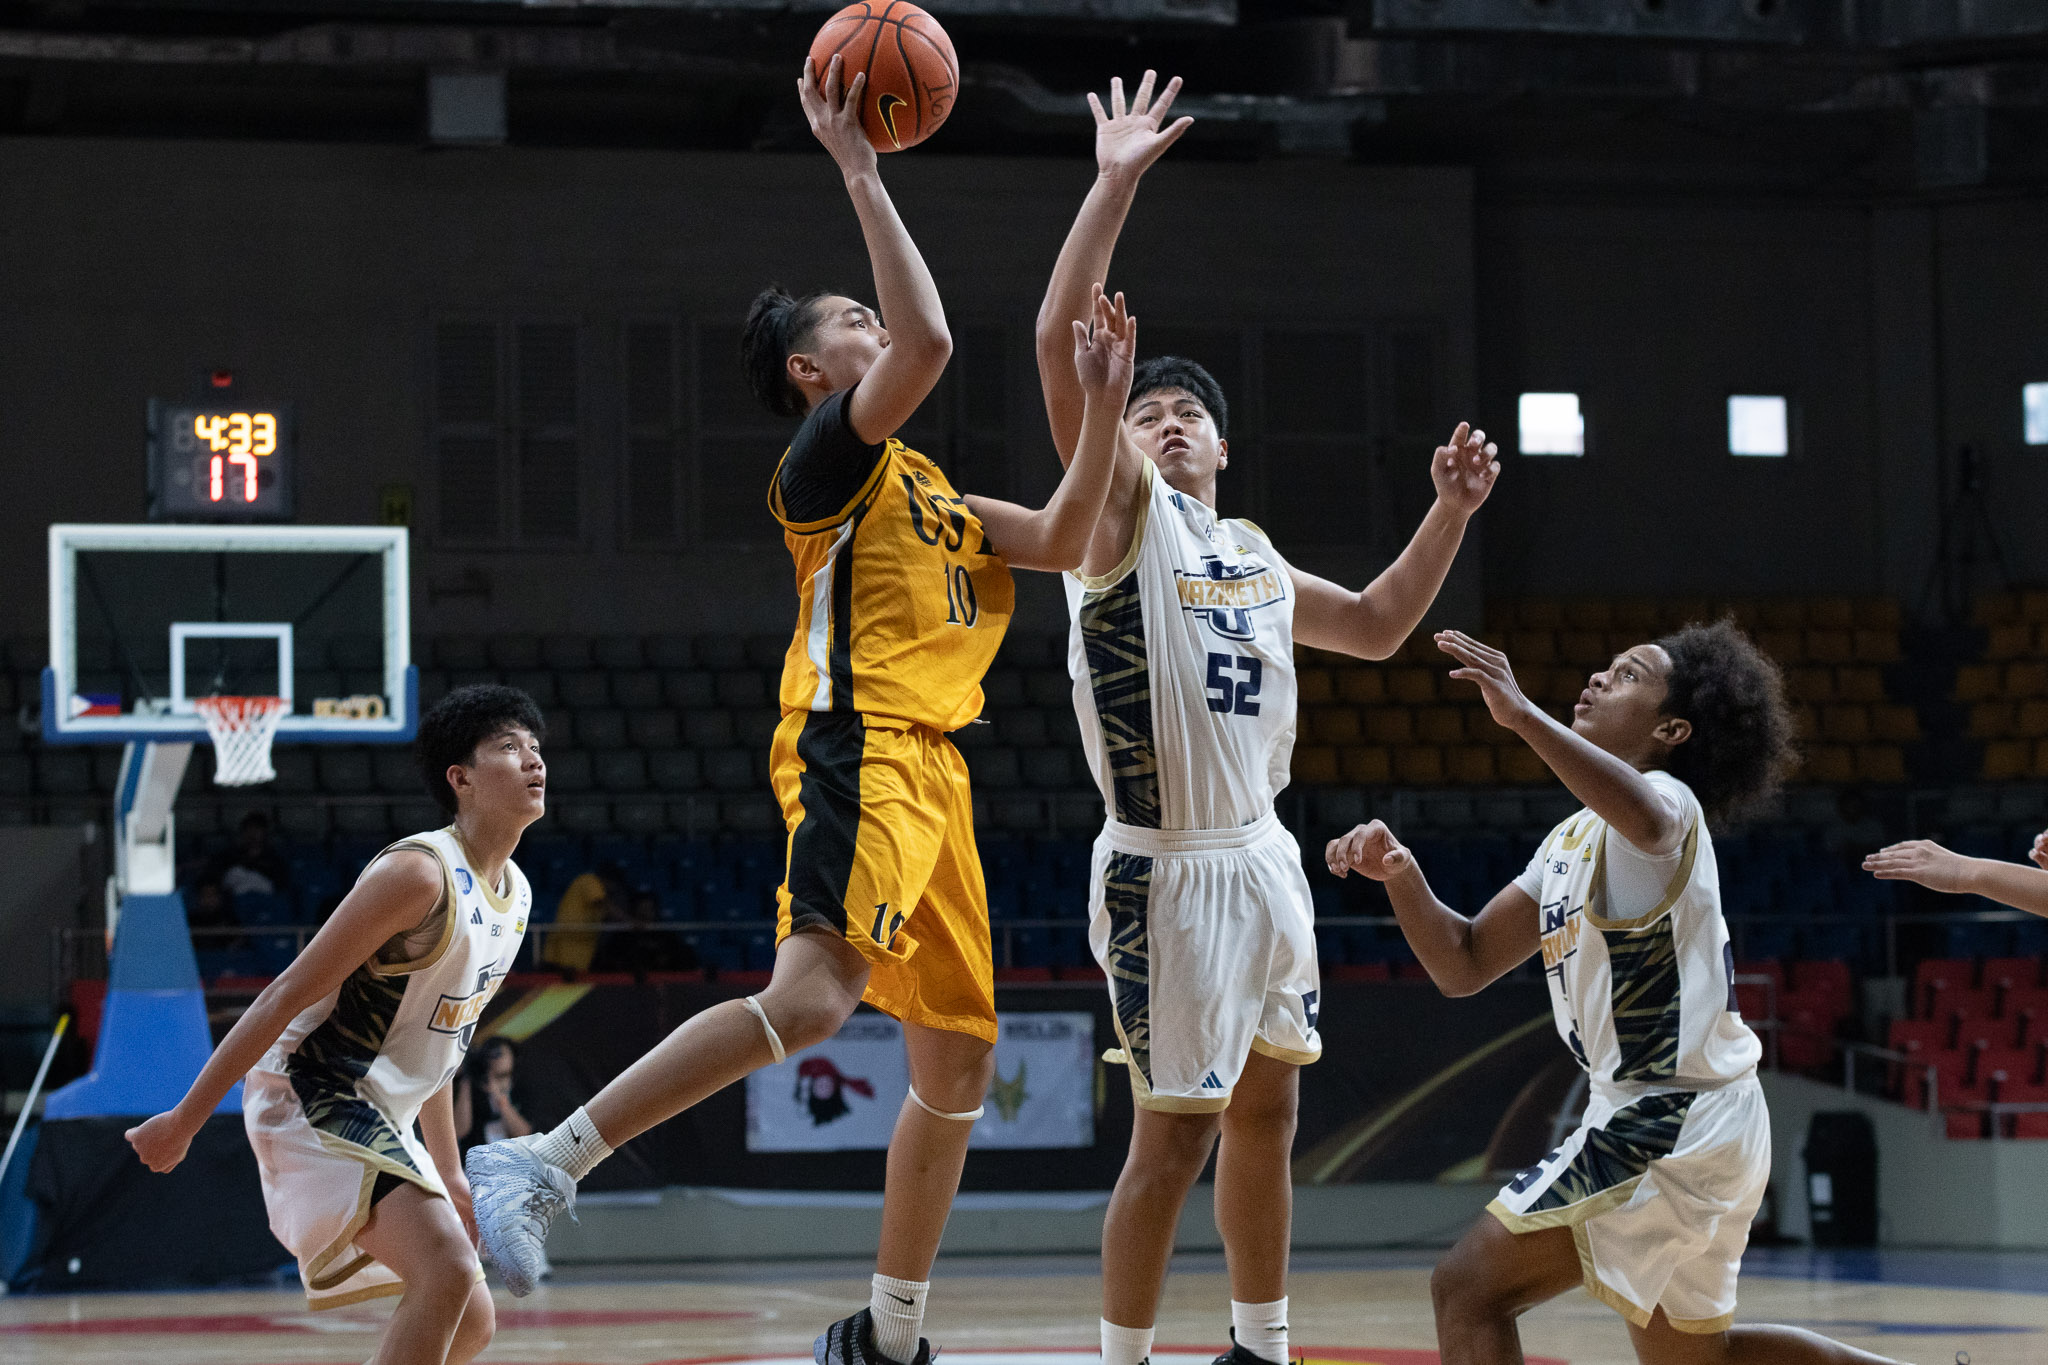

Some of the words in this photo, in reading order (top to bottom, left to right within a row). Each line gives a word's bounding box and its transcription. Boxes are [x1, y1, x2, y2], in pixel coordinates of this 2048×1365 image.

[195, 412, 277, 456] 4:33
[209, 451, 258, 503] 17
[943, 561, 978, 629] 10
[1206, 652, 1263, 717] 52
